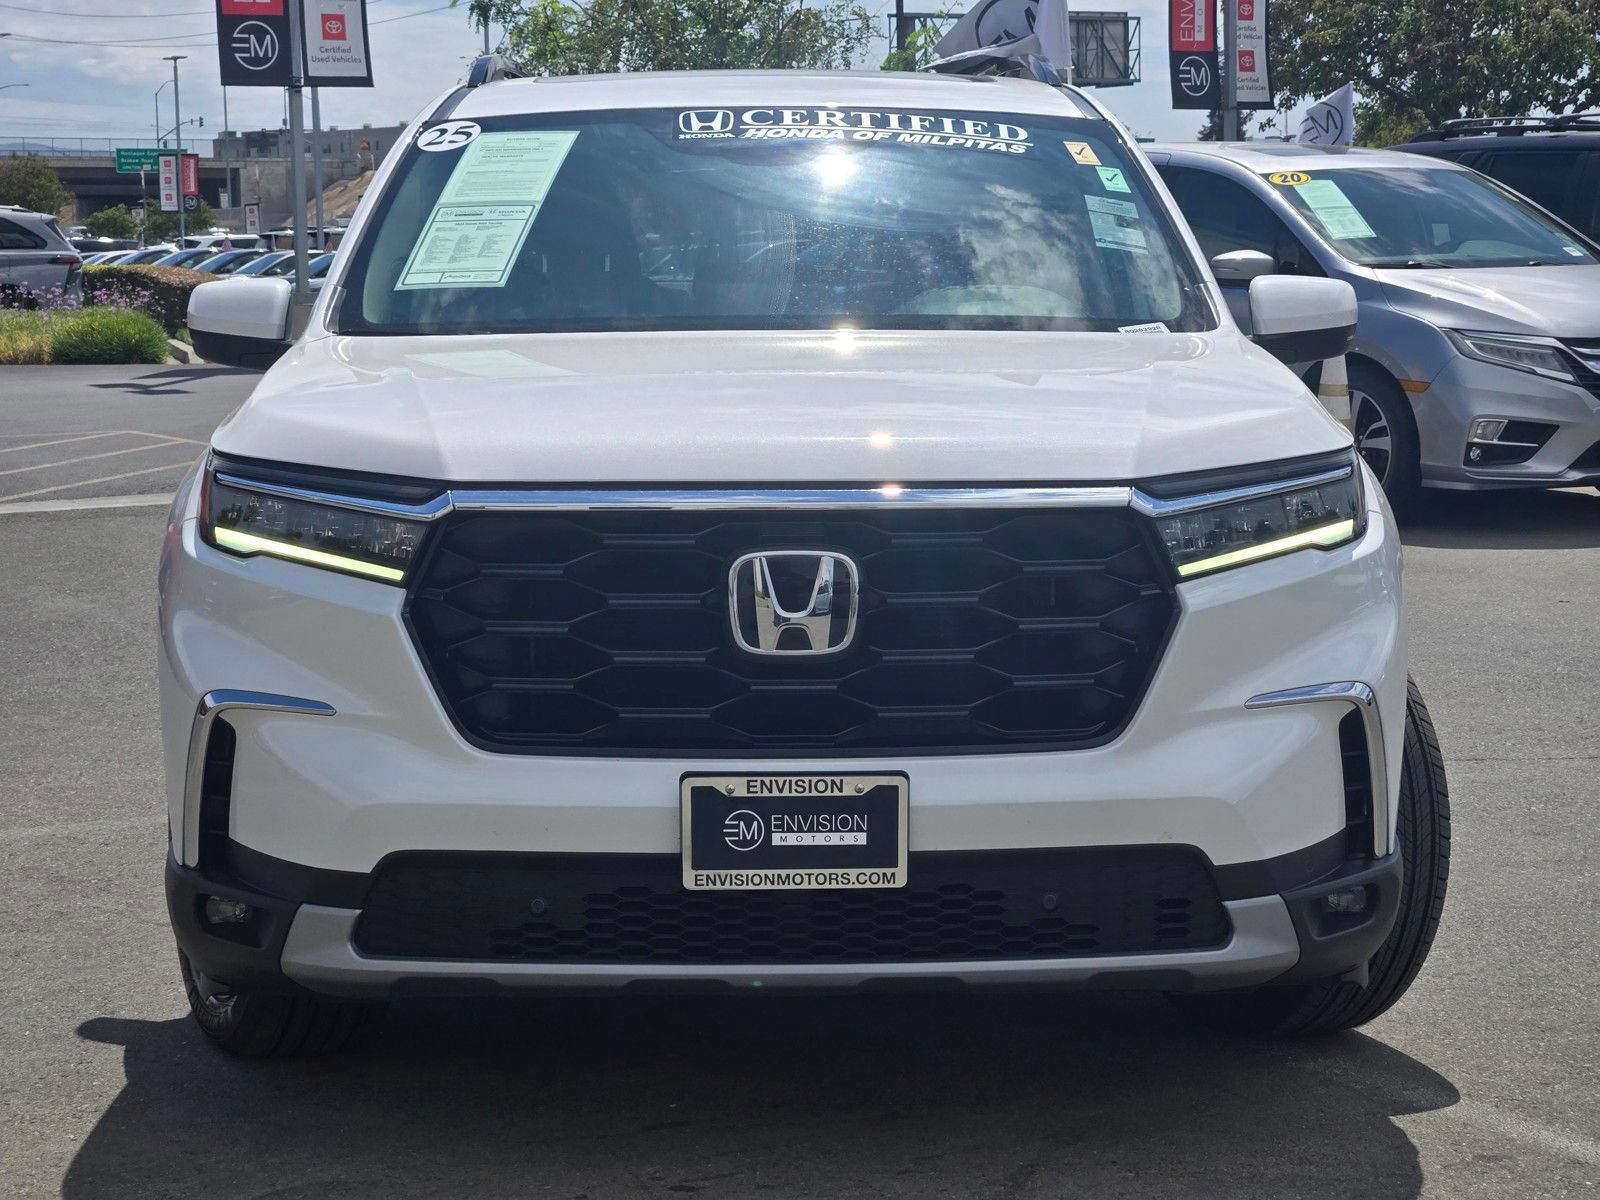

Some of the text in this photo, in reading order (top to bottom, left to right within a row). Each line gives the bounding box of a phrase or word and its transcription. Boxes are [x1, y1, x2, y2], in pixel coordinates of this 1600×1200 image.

[319, 46, 352, 54] Certified
[311, 55, 362, 63] Used Vehicles
[741, 109, 1029, 141] CERTIFIED
[422, 125, 477, 147] 25
[741, 128, 1027, 154] HONDA OF MILPITAS
[1279, 173, 1302, 184] 20
[746, 779, 844, 794] ENVISION
[771, 814, 867, 831] ENVISION
[779, 835, 859, 843] MOTORS
[694, 872, 896, 887] ENVISIONMOTORS.COM
